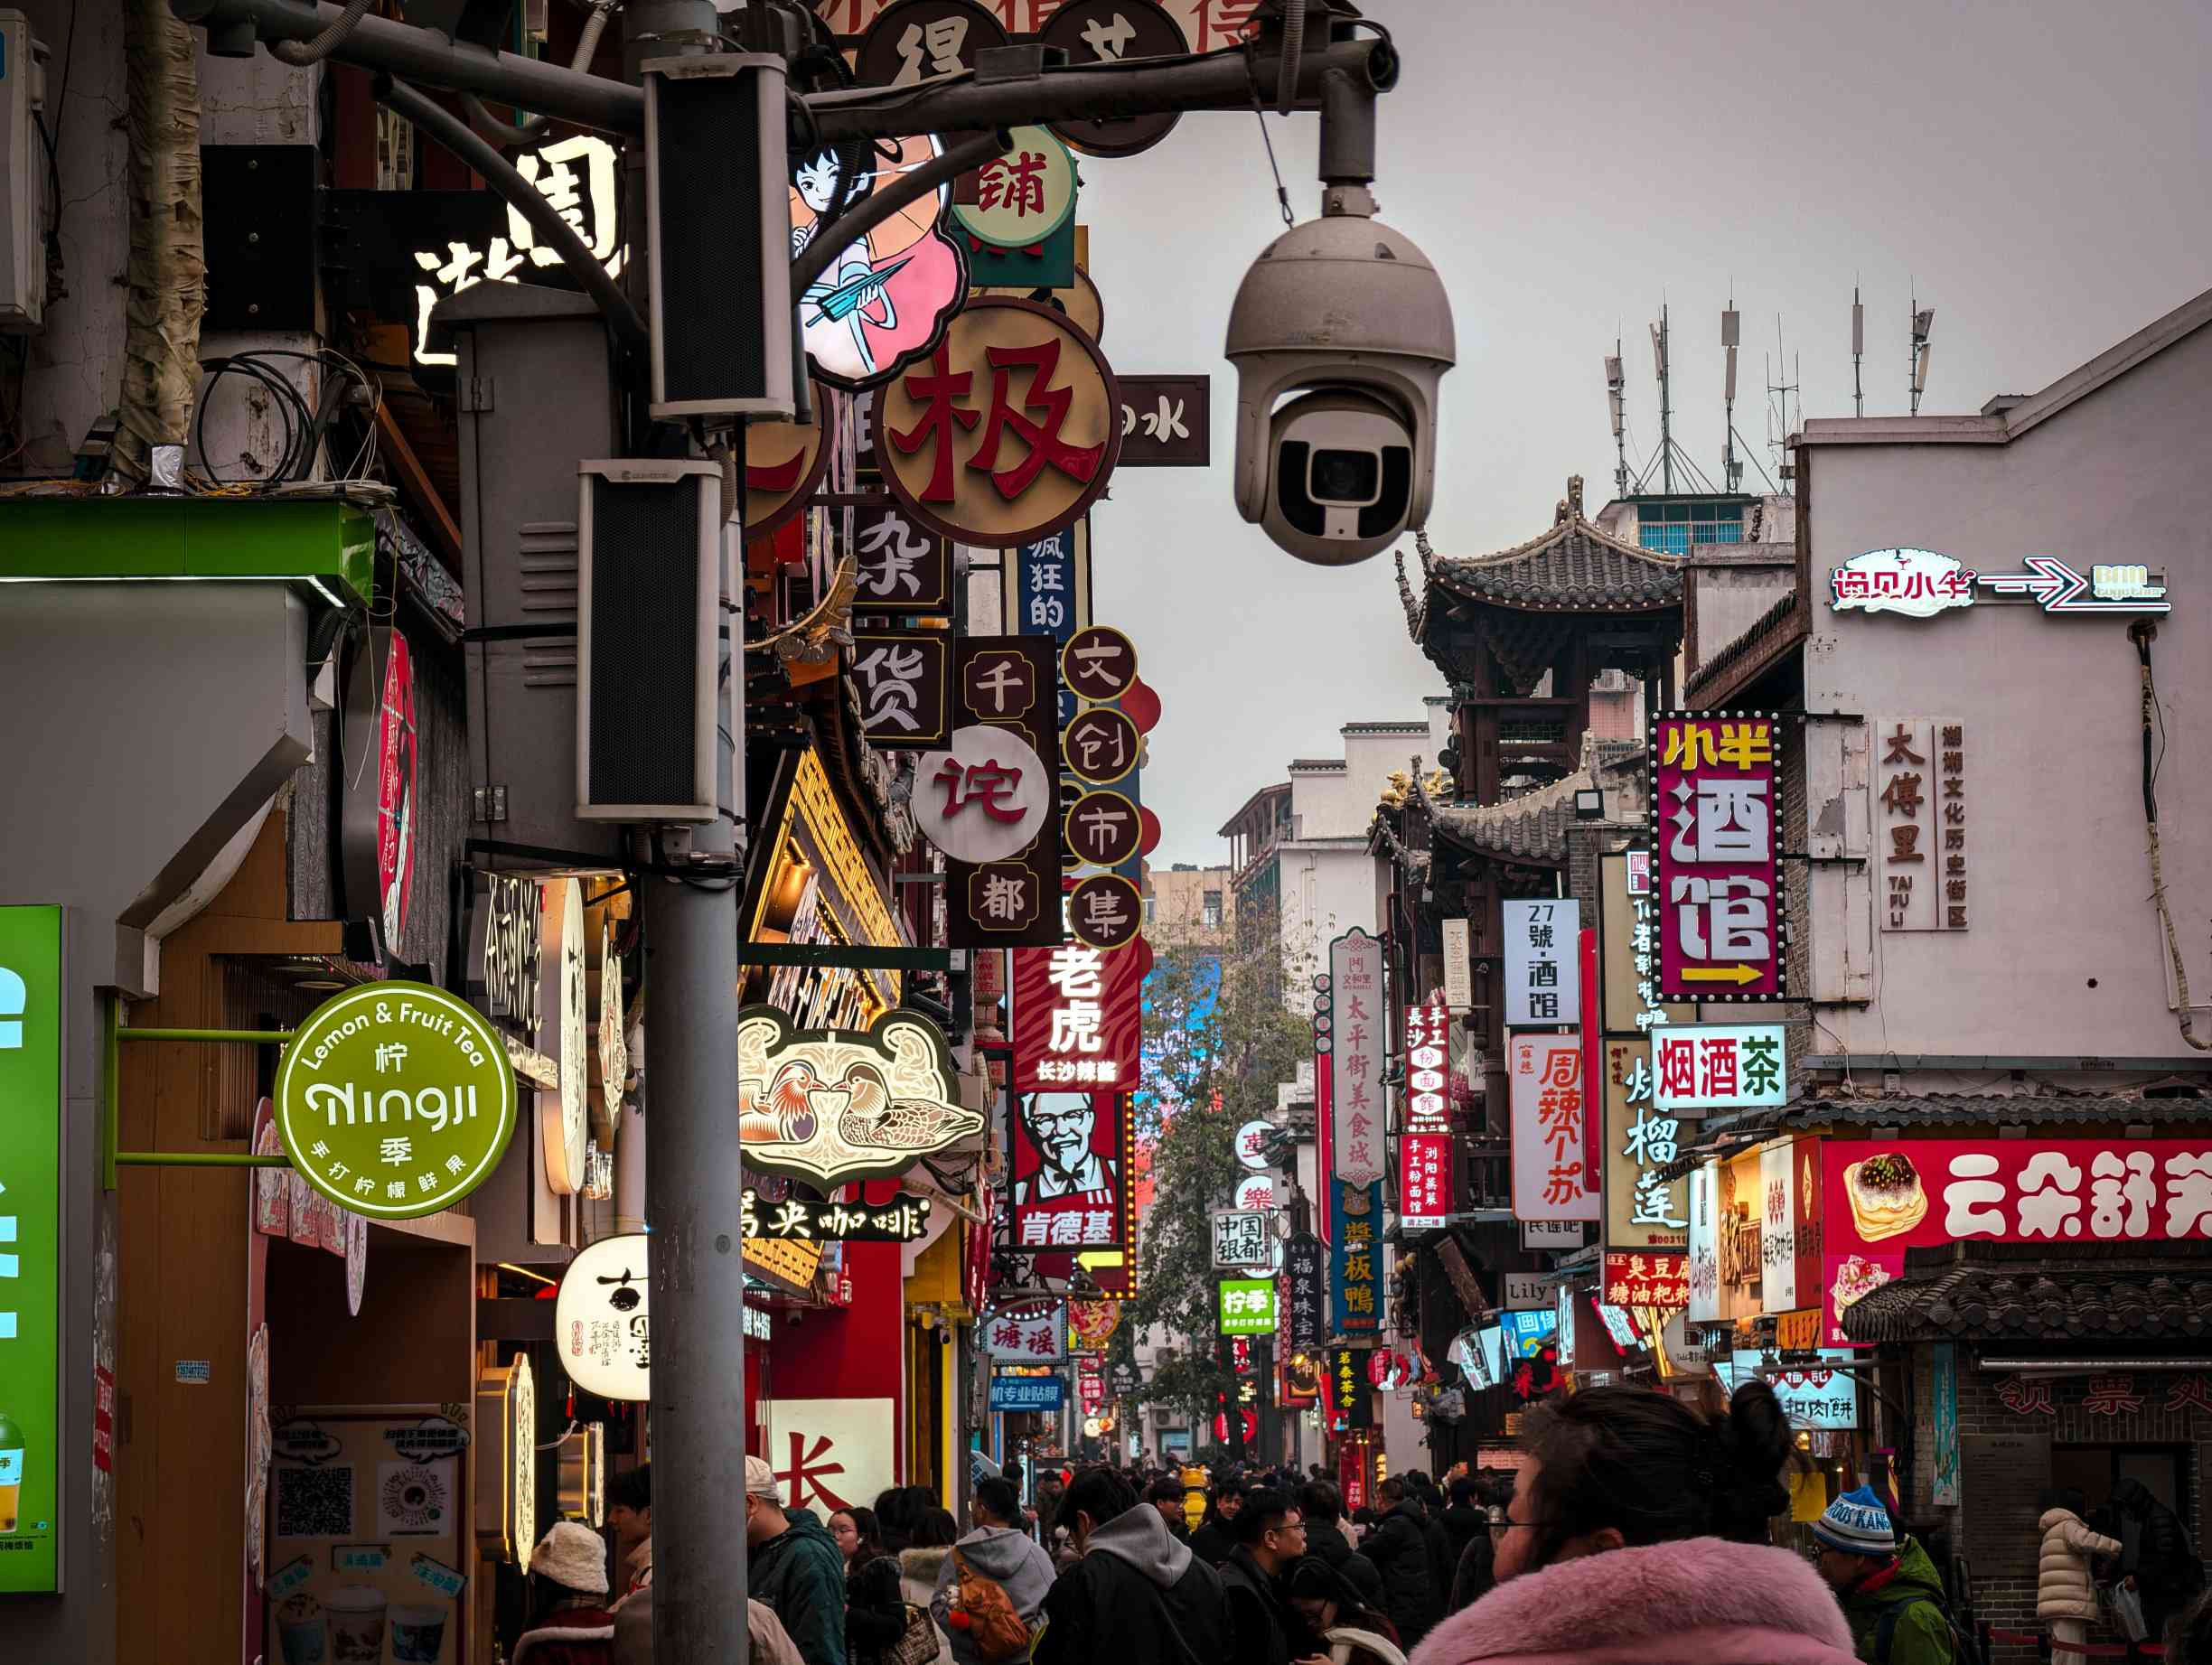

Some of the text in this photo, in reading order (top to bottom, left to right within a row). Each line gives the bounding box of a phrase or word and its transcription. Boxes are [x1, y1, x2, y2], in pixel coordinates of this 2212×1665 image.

[890, 331, 1105, 502] 极
[933, 758, 1028, 824] 诧
[1073, 636, 1129, 939] 文创市集
[1888, 875, 1913, 892] TAI
[1049, 947, 1103, 1052] 老虎
[301, 1002, 485, 1071] Lemon & Fruit Tea
[375, 1042, 409, 1073] 柠
[1658, 1035, 1780, 1099] 烟酒茶
[380, 1137, 412, 1167] 季
[1021, 1211, 1114, 1245] 肯德基
